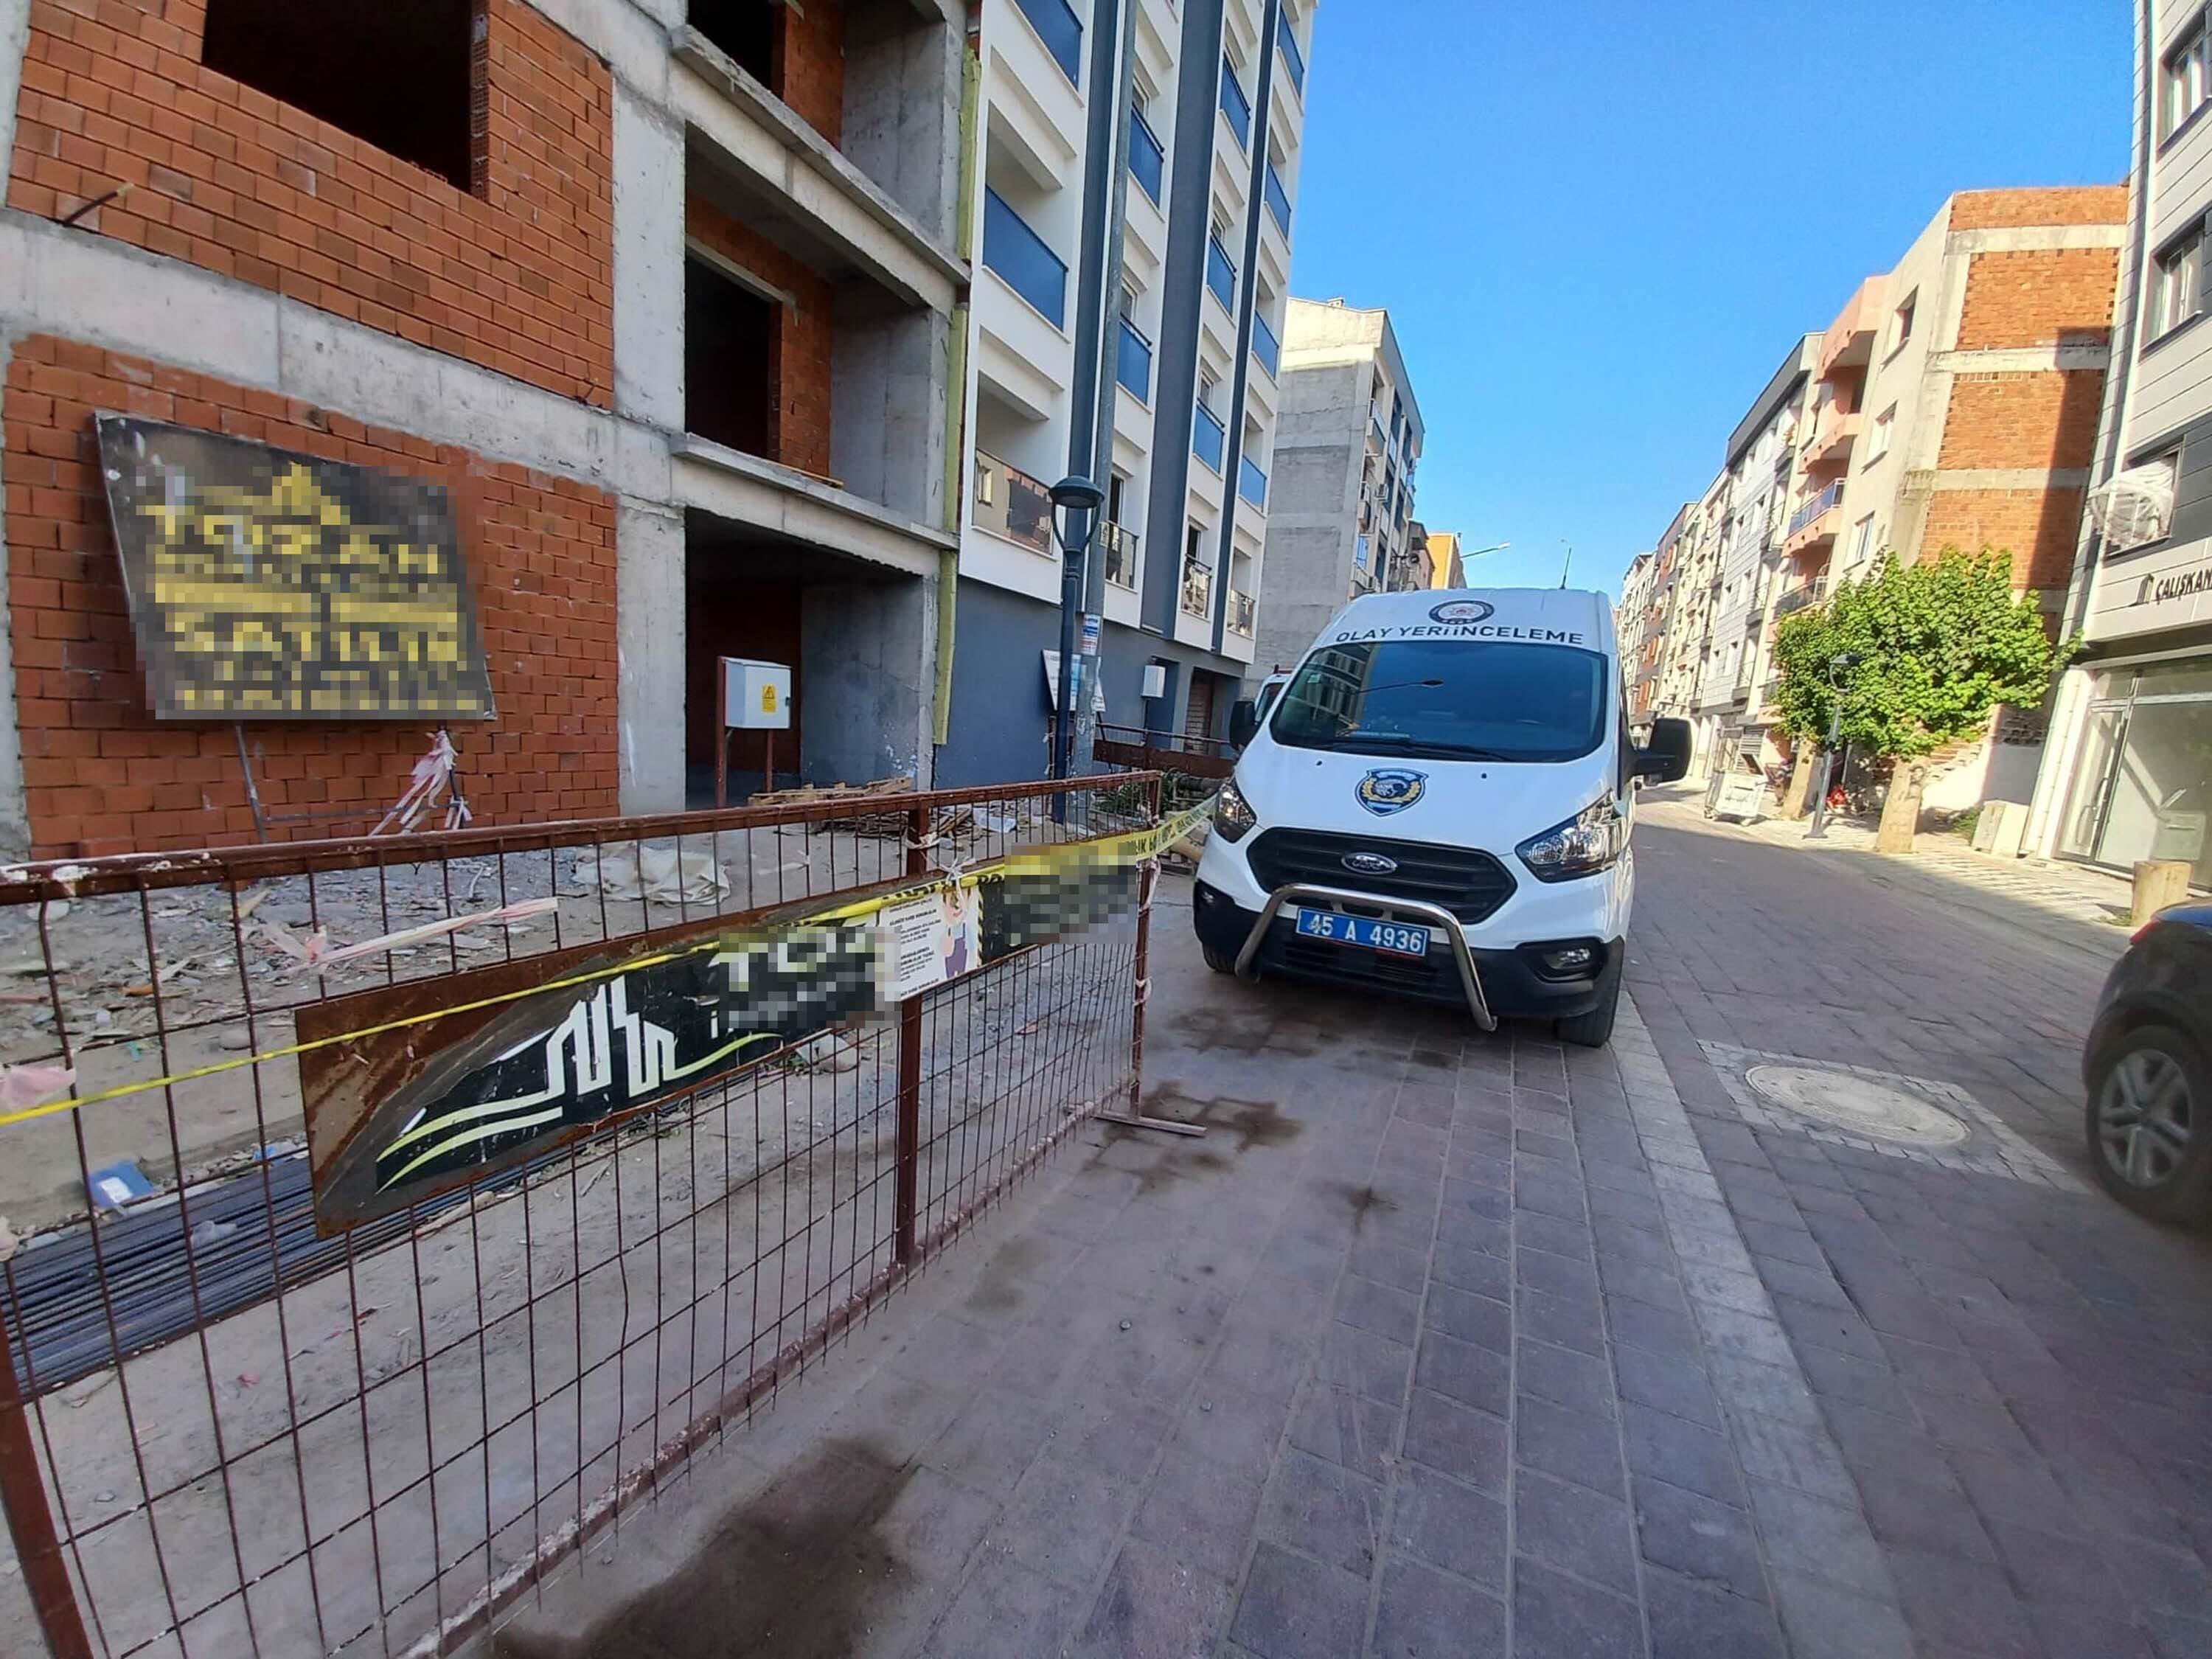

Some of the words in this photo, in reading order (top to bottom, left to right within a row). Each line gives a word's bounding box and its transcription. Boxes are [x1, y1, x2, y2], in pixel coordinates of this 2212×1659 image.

[1336, 626, 1393, 642] OLAY
[1307, 914, 1334, 936] 45
[1344, 920, 1357, 942] A
[1369, 925, 1422, 952] 4936
